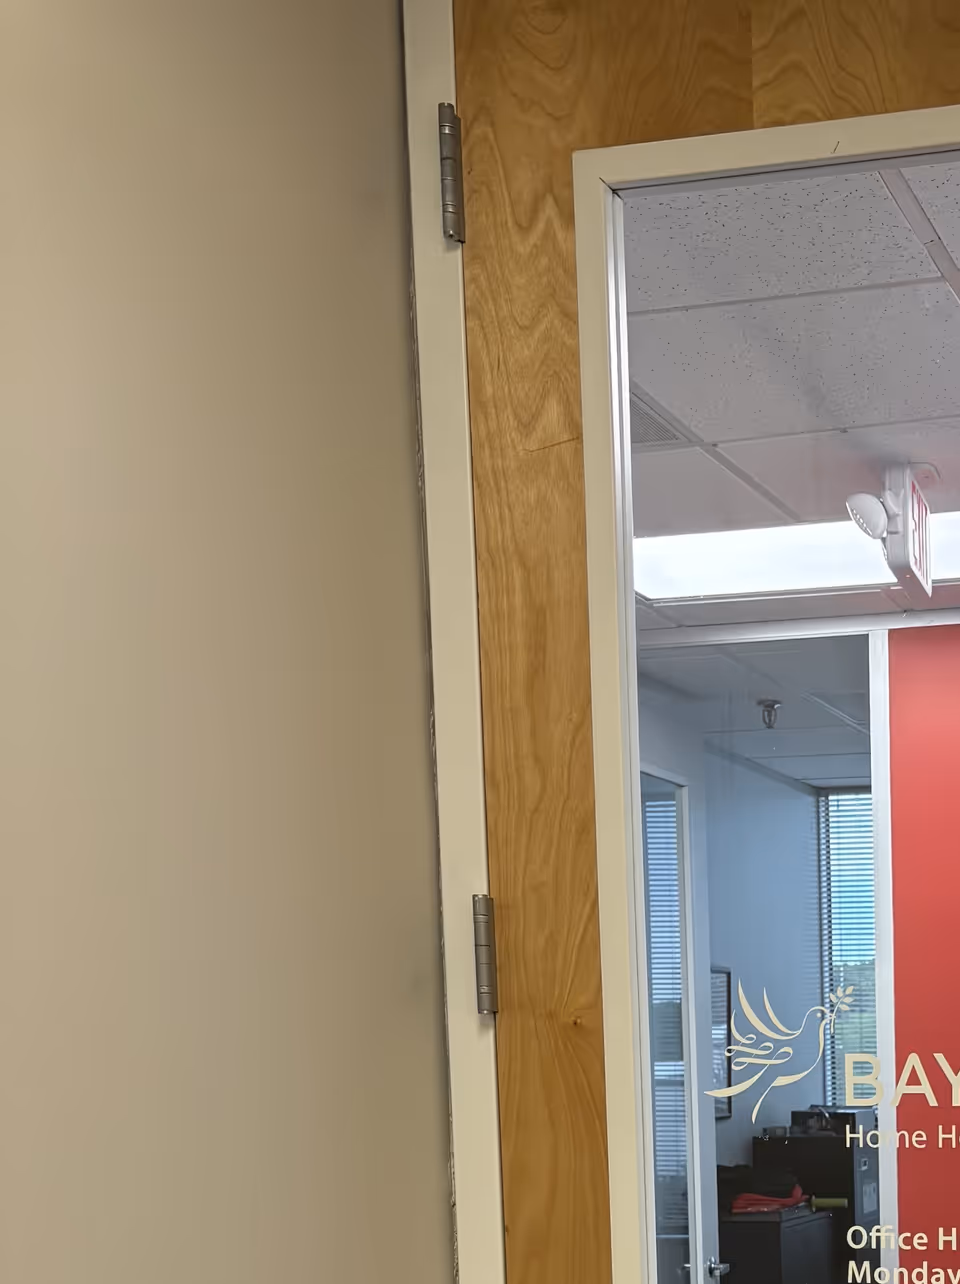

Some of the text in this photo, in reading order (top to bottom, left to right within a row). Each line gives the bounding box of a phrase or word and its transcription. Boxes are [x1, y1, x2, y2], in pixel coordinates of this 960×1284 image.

[911, 480, 929, 587] EXIT
[844, 1125, 927, 1149] Home
[846, 1225, 928, 1251] Office
